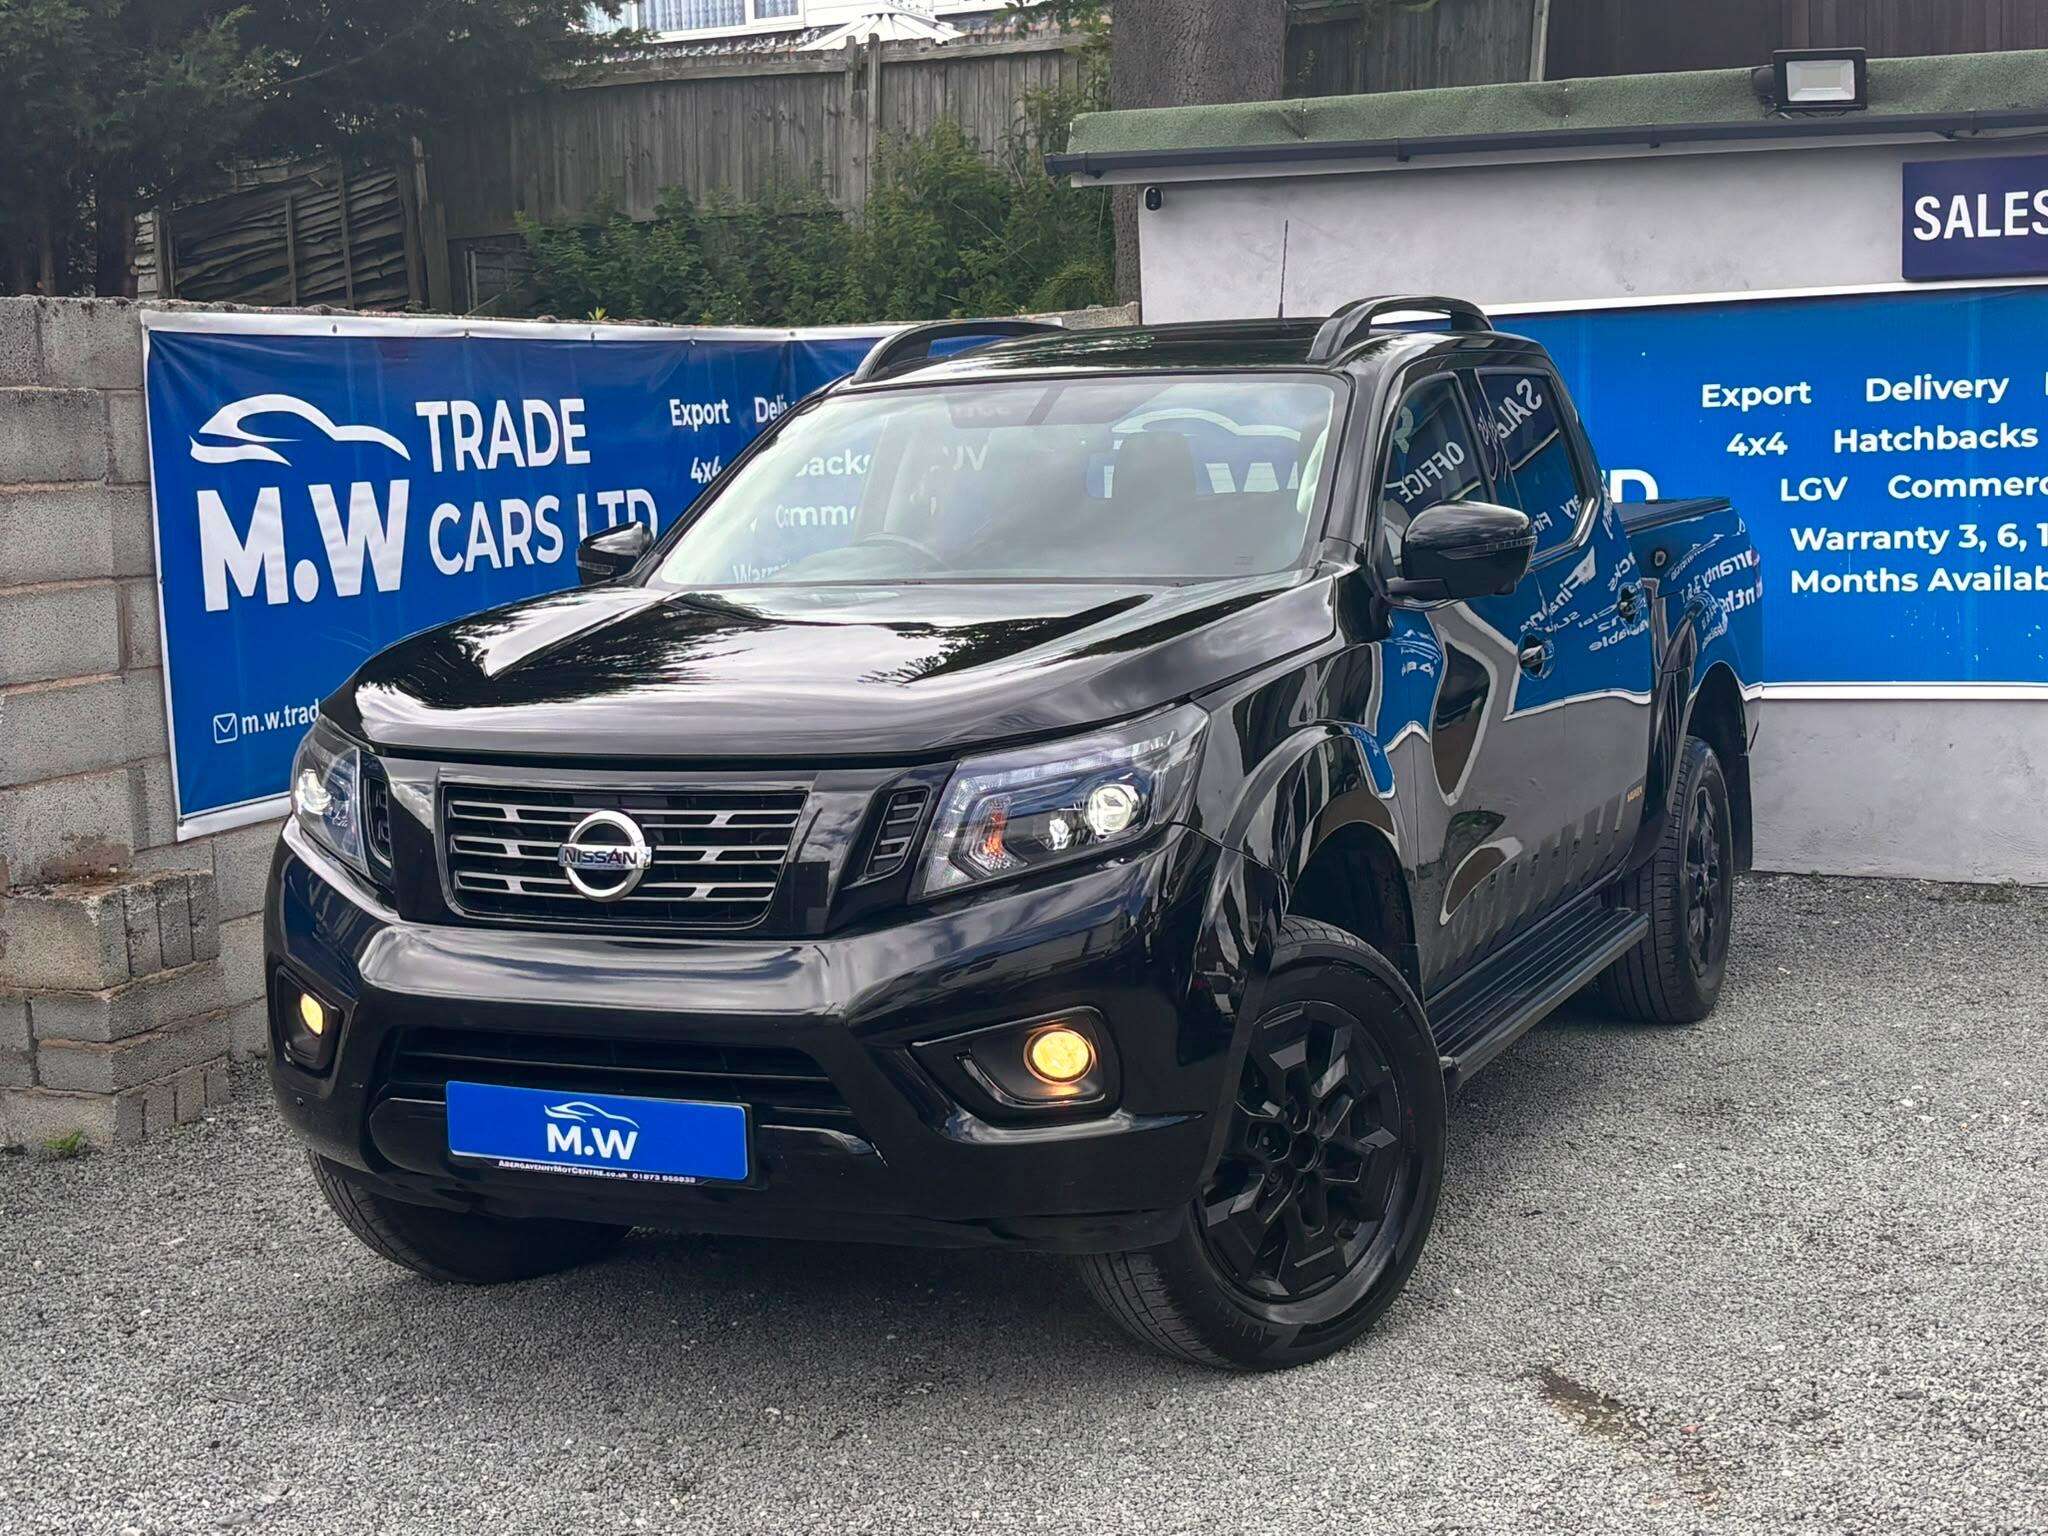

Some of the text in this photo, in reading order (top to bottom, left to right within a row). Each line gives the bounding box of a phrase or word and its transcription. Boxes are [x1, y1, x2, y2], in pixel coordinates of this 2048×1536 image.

[1700, 381, 1812, 412] Export
[1865, 374, 2010, 404] Delivery
[669, 398, 731, 432] Export
[415, 397, 592, 473] TRADE
[1726, 422, 2039, 457] 4x4 Hatchbacks
[690, 455, 723, 484] 4x4
[1780, 477, 1848, 502] LGV
[196, 478, 411, 613] M.W
[427, 494, 565, 577] CARS
[1789, 524, 1952, 557] Warranty
[1957, 523, 1988, 553] 3,
[1996, 522, 2028, 553] 6,
[1790, 568, 1920, 594] Months
[563, 848, 638, 865] NISSAN
[546, 1123, 639, 1161] M.W
